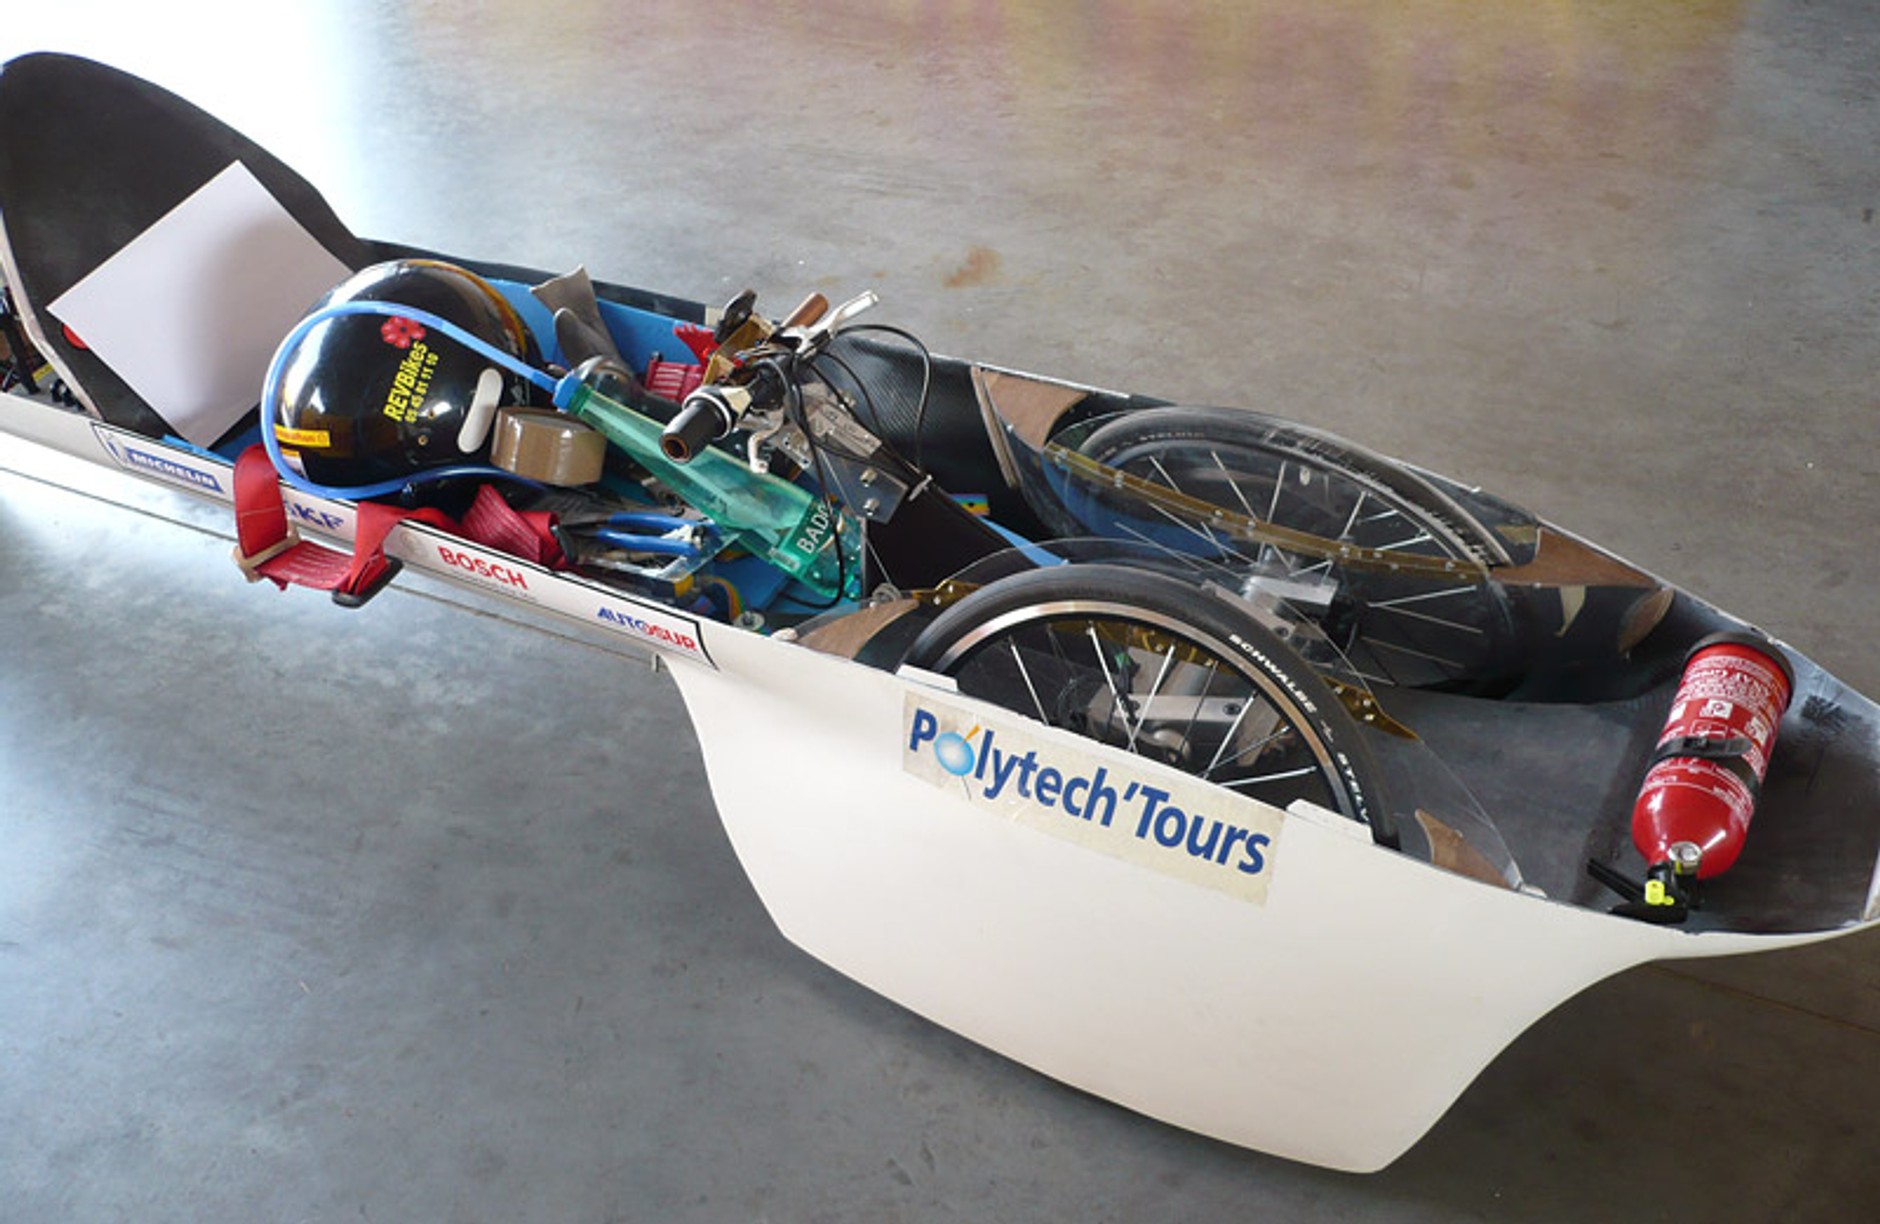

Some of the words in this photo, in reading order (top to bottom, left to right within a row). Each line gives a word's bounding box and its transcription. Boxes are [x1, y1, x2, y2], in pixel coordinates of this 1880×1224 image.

[131, 452, 217, 487] MICHELIN
[437, 545, 529, 591] BOSCH
[596, 606, 697, 650] AUTOSUR
[1228, 633, 1318, 714] SCHWALBE
